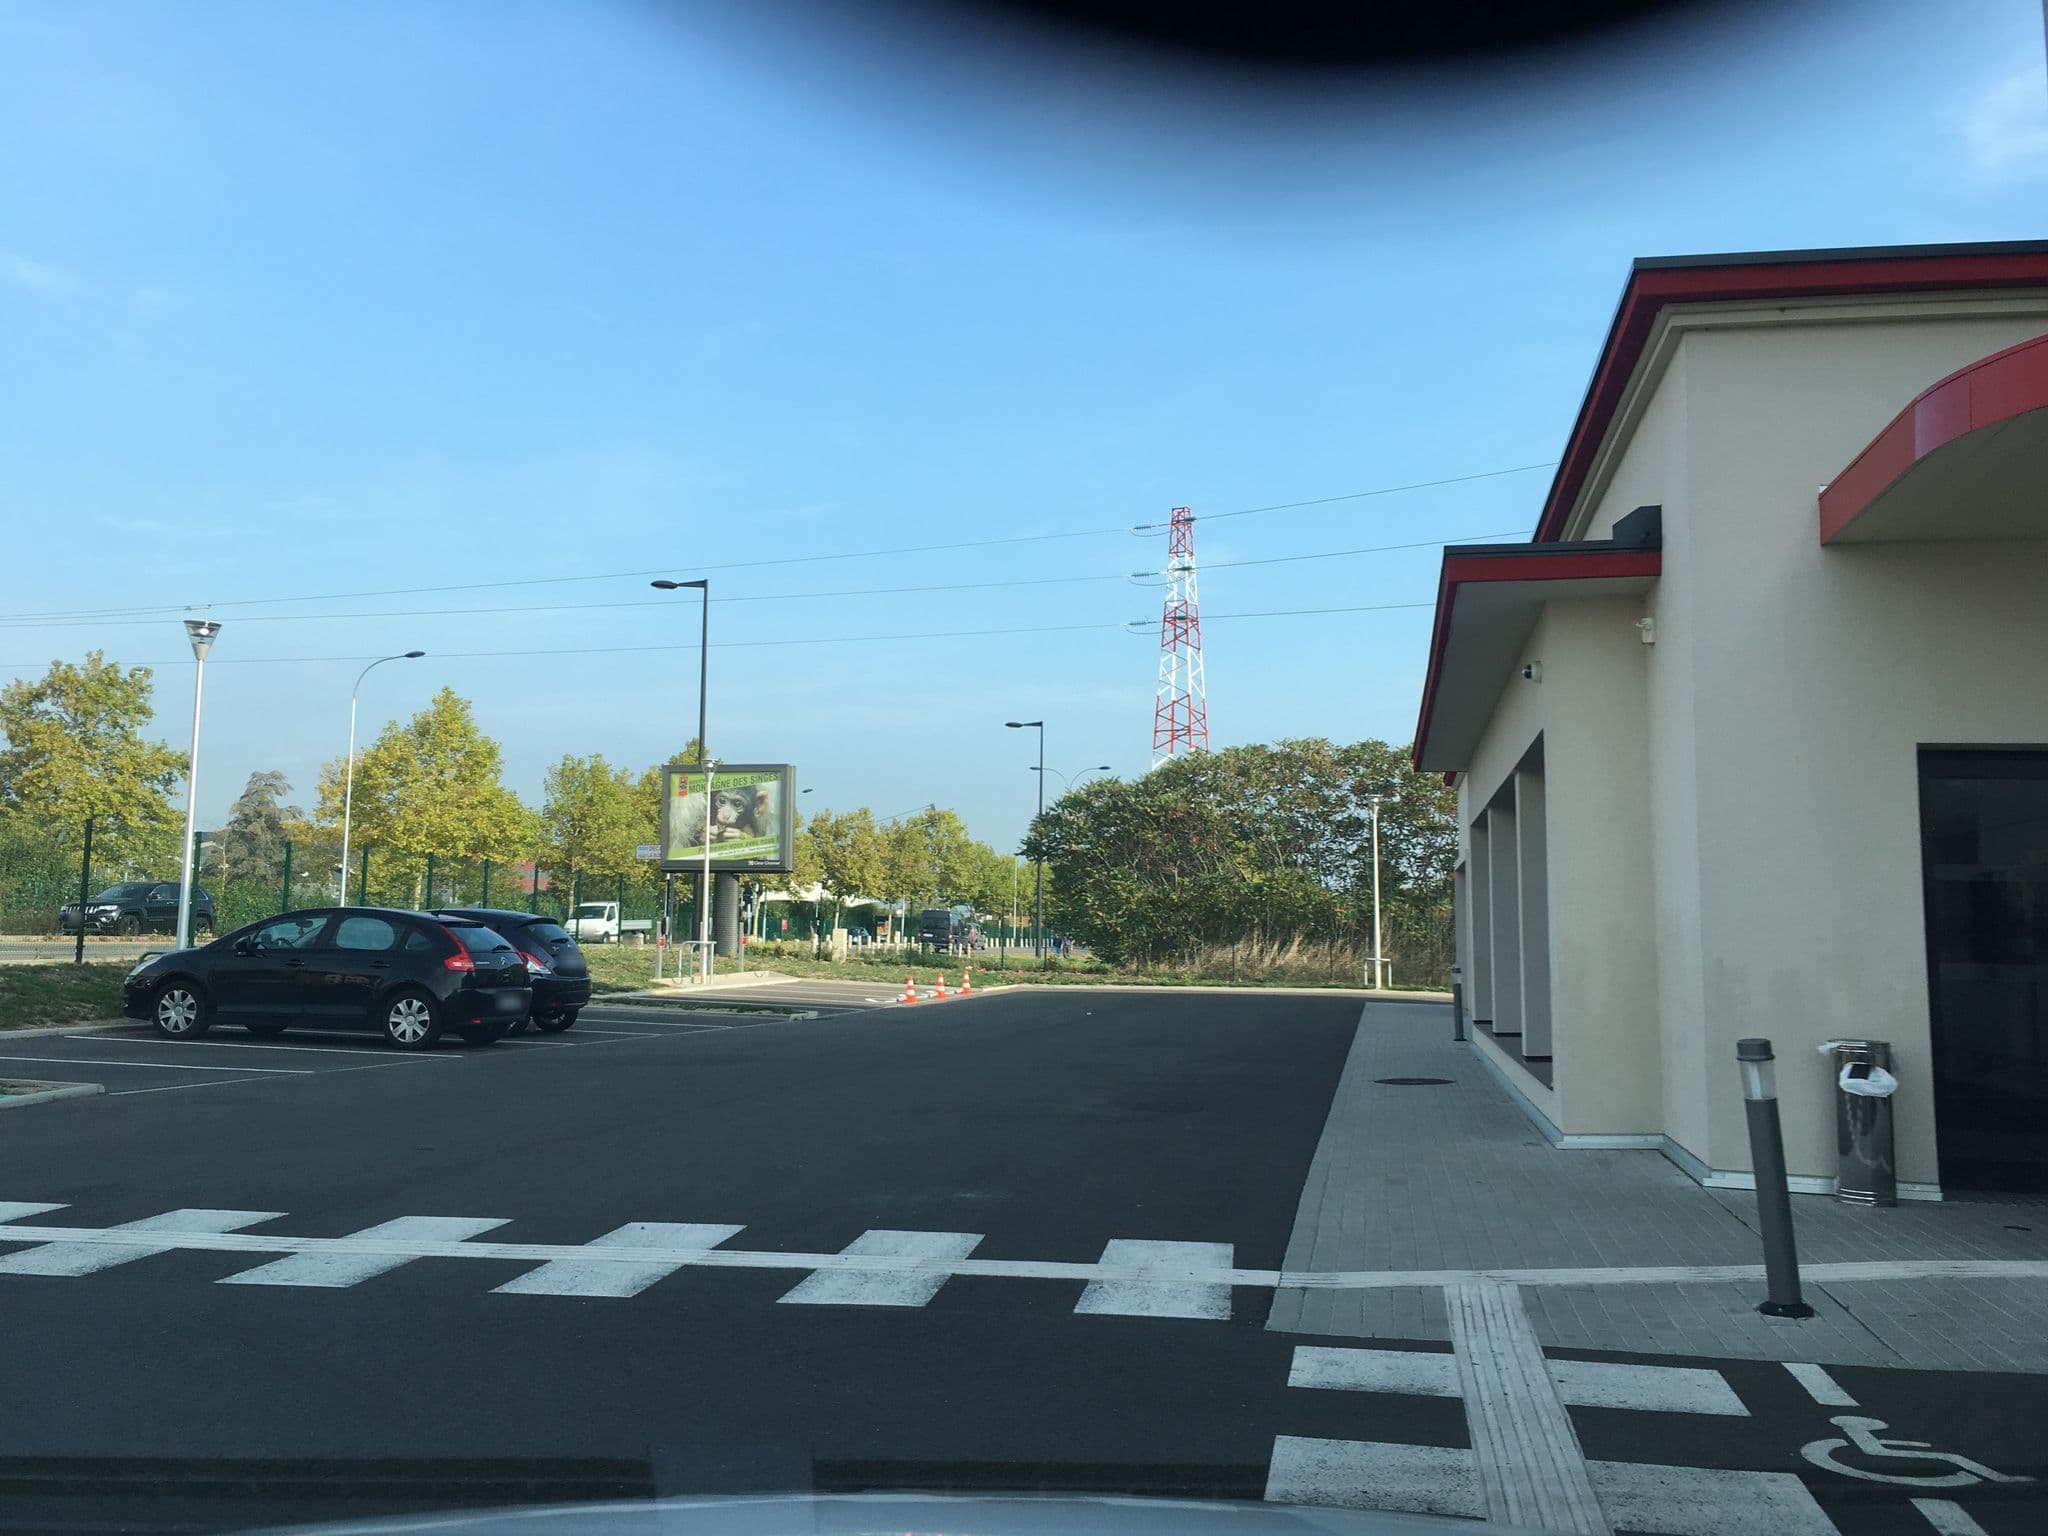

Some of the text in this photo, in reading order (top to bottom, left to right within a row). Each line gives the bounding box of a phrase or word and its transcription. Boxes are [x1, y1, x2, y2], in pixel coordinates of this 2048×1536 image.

[688, 779, 733, 793] MONAGNE
[733, 776, 748, 787] DES
[750, 772, 778, 785] SINGES
